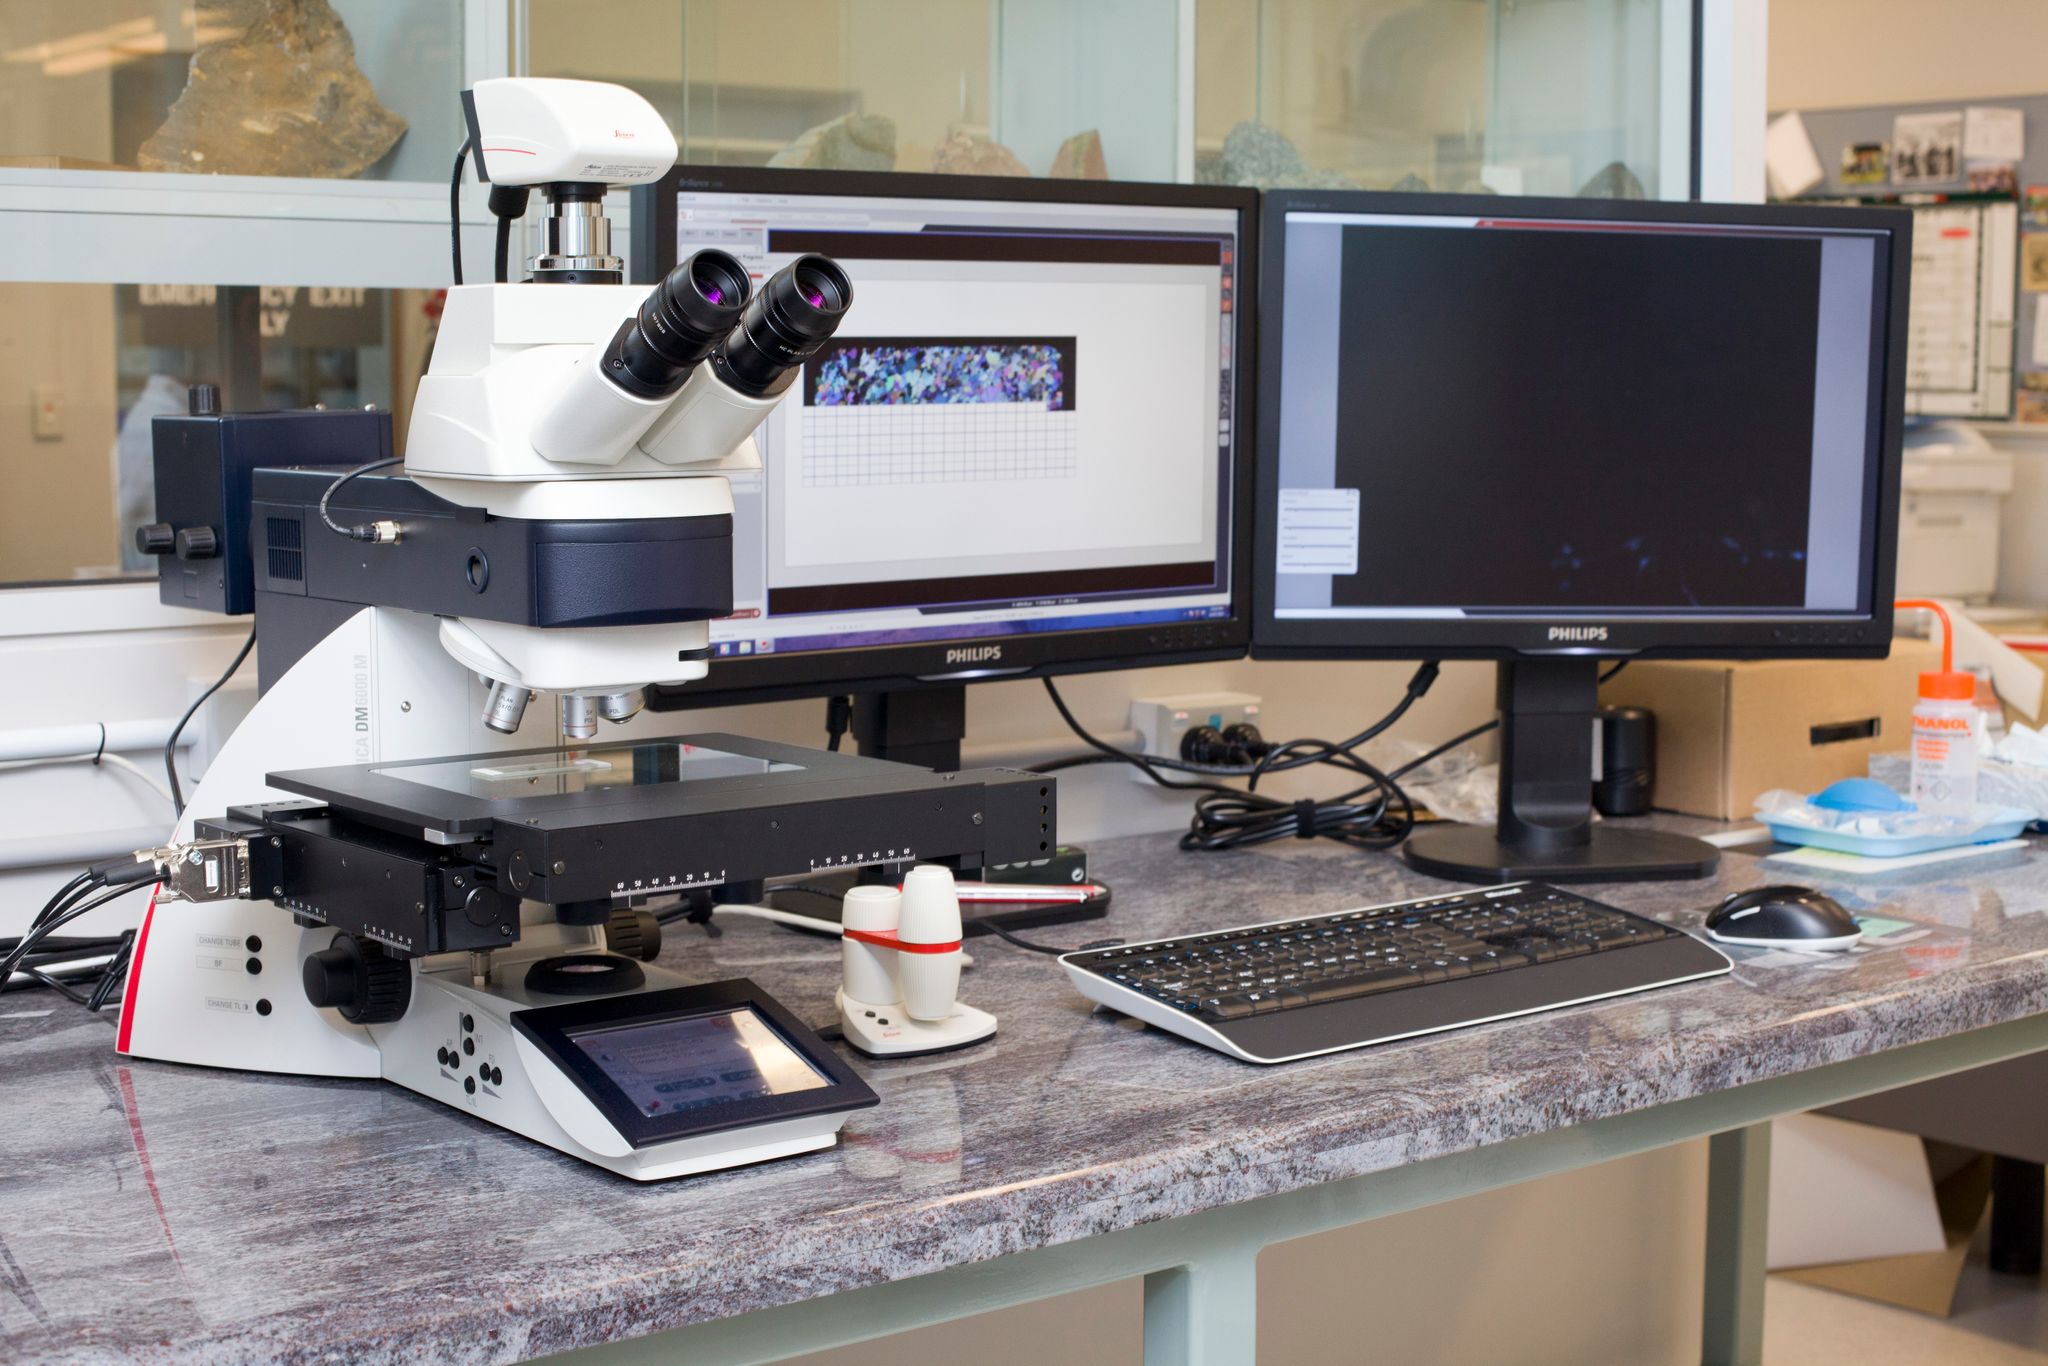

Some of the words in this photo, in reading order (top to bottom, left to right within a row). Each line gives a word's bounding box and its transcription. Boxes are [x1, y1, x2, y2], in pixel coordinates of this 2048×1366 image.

[1548, 626, 1608, 641] PHILIPS
[946, 645, 1002, 663] PHILIPS
[810, 858, 814, 866] 0
[841, 855, 848, 863] 20
[857, 853, 864, 861] 30
[872, 850, 879, 858] 40
[888, 848, 895, 857] 50
[903, 847, 910, 855] 60
[617, 881, 625, 890] 60
[634, 879, 642, 888] 50
[652, 877, 660, 886] 40
[669, 875, 677, 884] 30
[686, 873, 694, 881] 20
[703, 871, 710, 879] 10
[721, 869, 726, 877] 0
[214, 959, 223, 968] BF
[207, 999, 233, 1010] CHANGE
